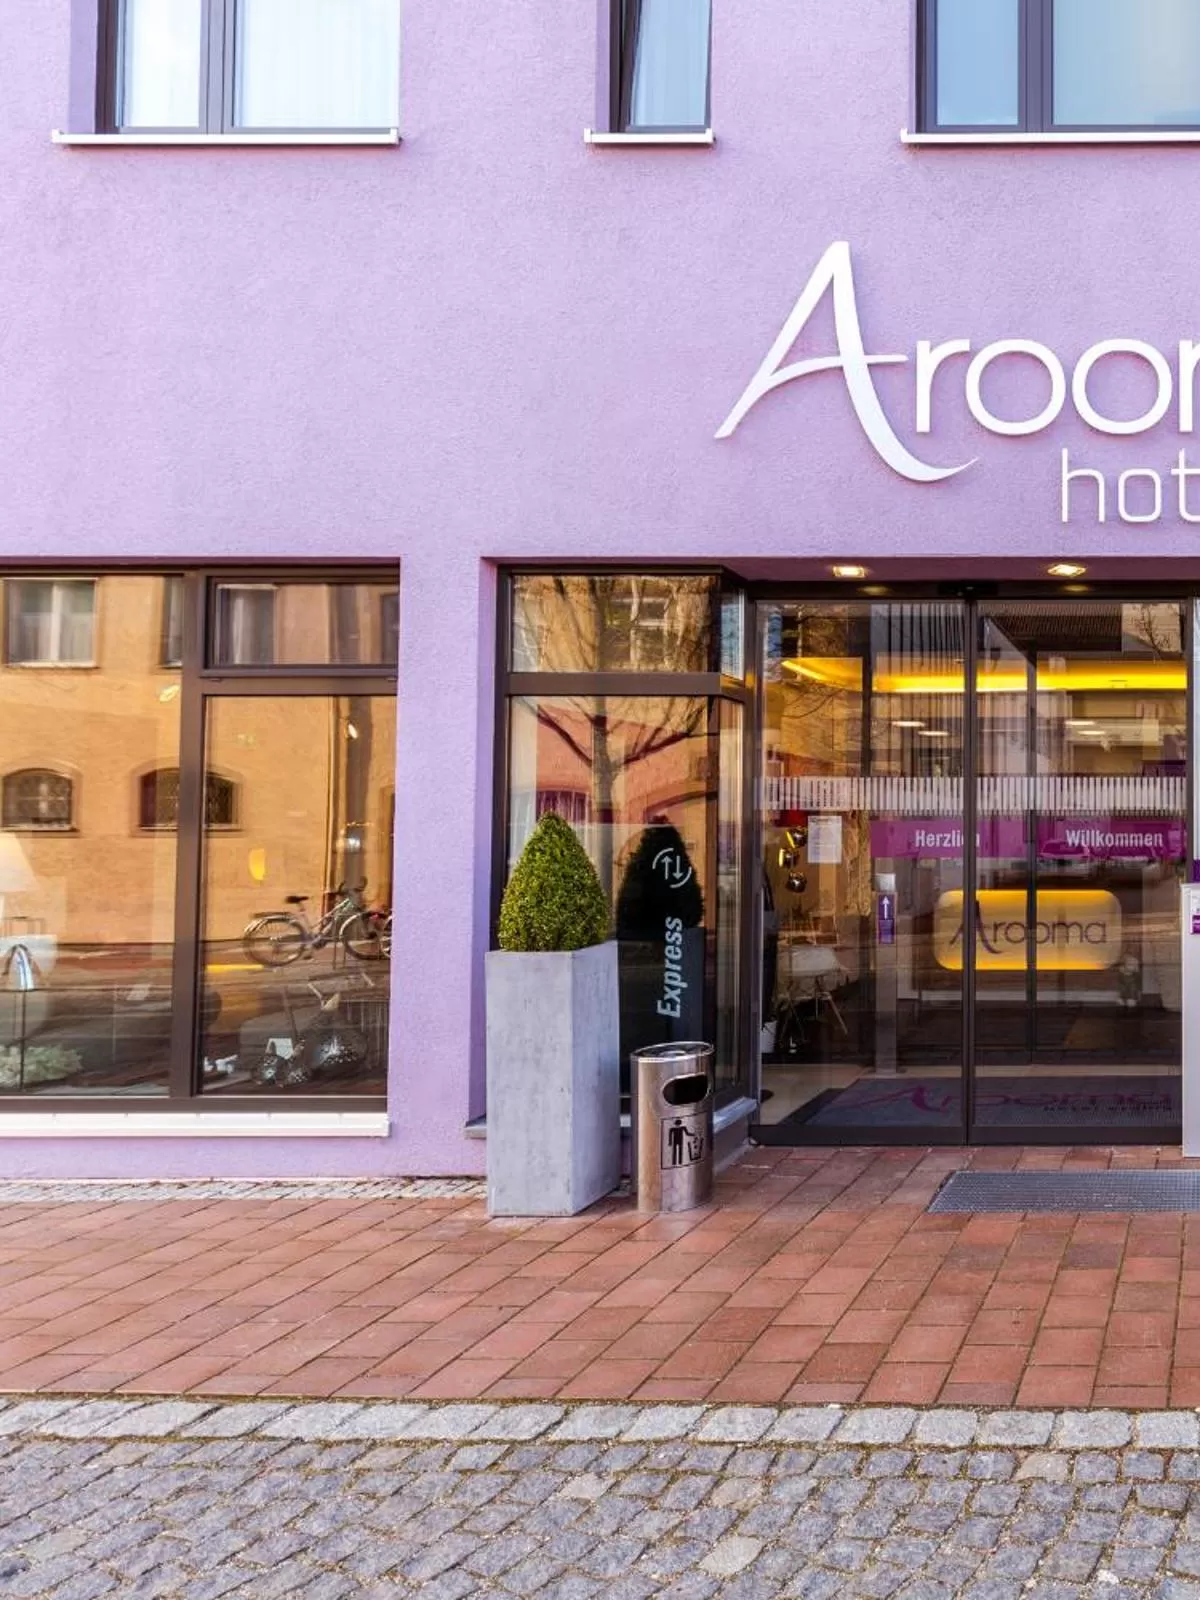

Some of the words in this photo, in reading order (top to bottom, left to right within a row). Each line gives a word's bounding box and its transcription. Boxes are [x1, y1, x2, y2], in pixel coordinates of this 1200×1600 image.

[914, 829, 980, 848] Herzli
[1065, 829, 1164, 848] Willkommen
[656, 916, 688, 1018] Express
